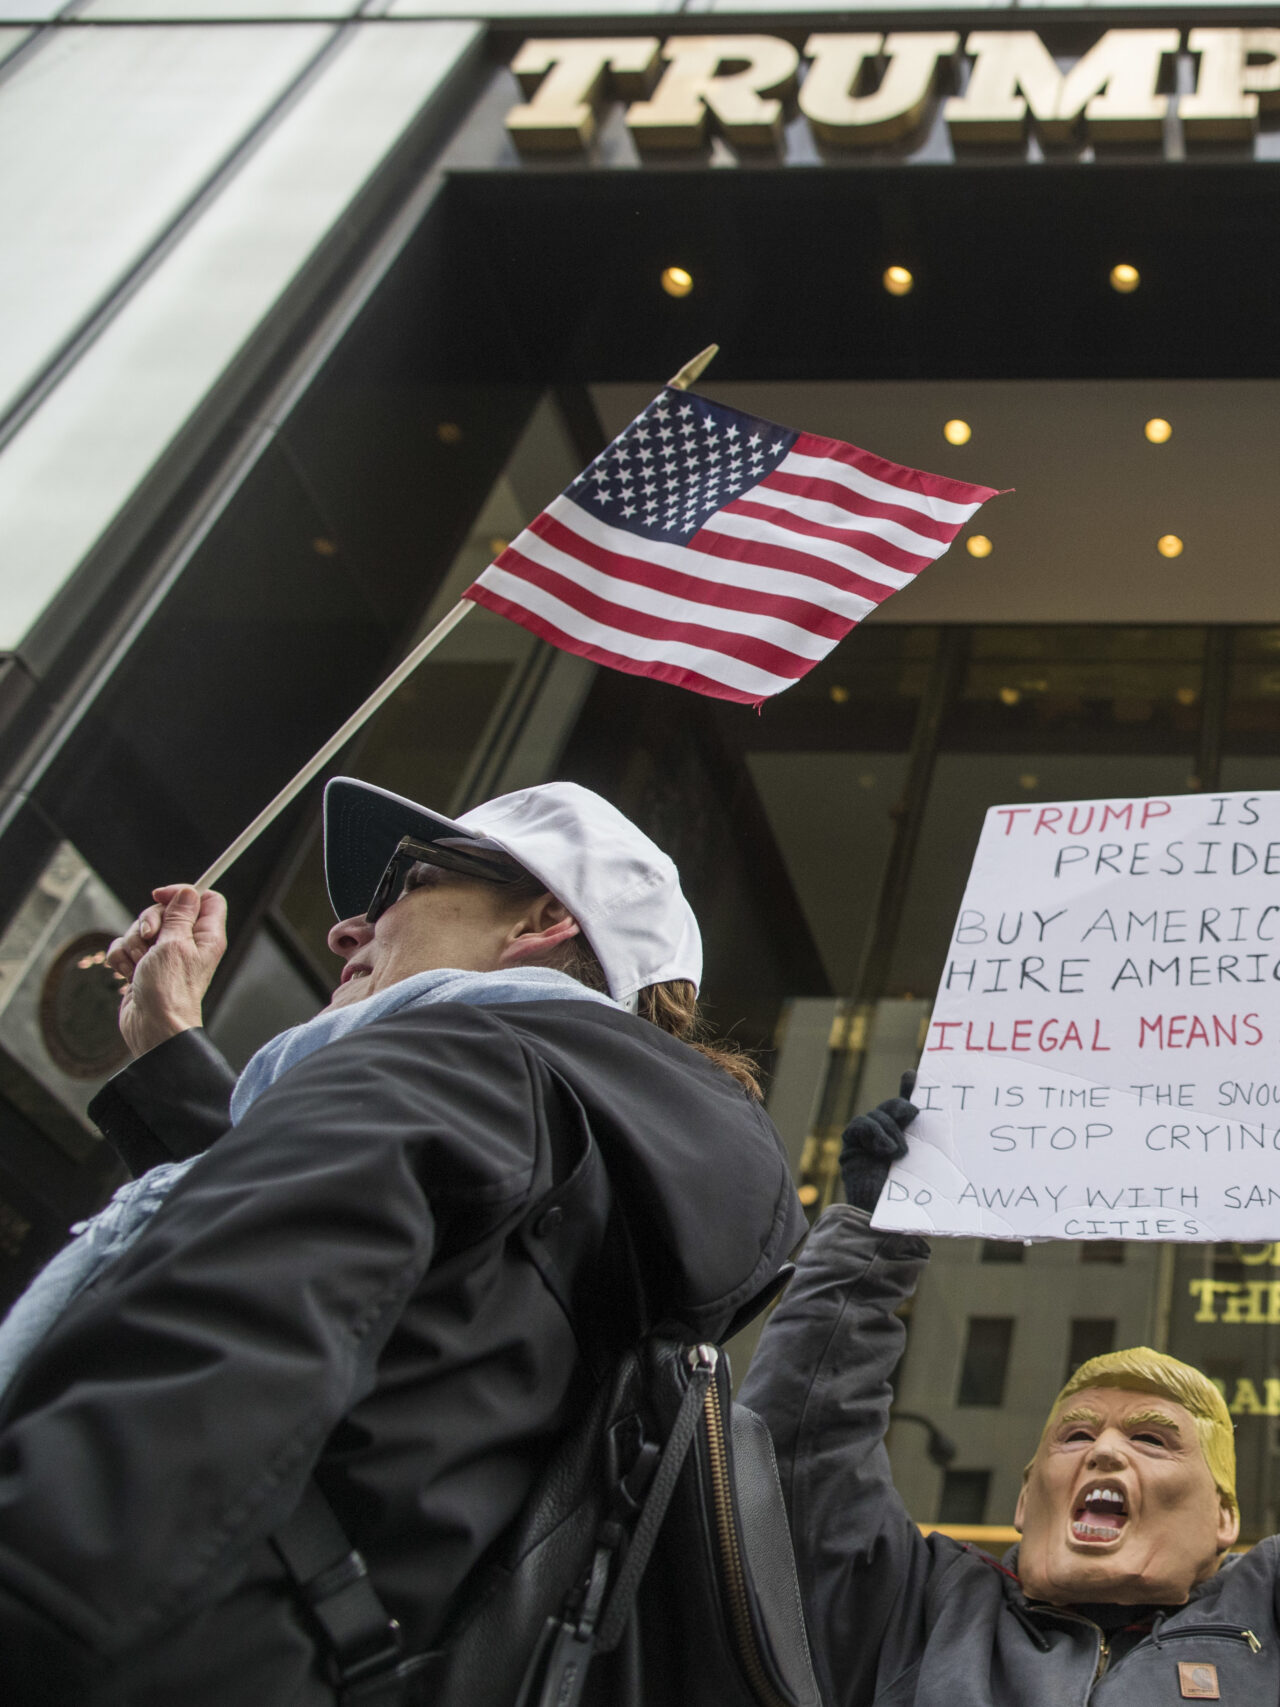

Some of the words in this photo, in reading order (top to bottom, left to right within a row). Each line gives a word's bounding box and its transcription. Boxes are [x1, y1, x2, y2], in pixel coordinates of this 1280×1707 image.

[997, 800, 1172, 836] TRUMP
[1207, 797, 1261, 826] IS
[956, 909, 1068, 944] BUY
[945, 956, 1091, 994] HIRE
[926, 1018, 1111, 1052] ILLEGAL
[1138, 1011, 1263, 1049] MEANS
[918, 1085, 975, 1111] IT
[994, 1086, 1025, 1108] IS
[1039, 1086, 1111, 1108] TIME
[1129, 1083, 1197, 1107] THE
[989, 1123, 1113, 1152] STOP
[958, 1184, 1067, 1212] AWAY
[1086, 1185, 1199, 1210] WITH
[1064, 1218, 1200, 1236] CITIES
